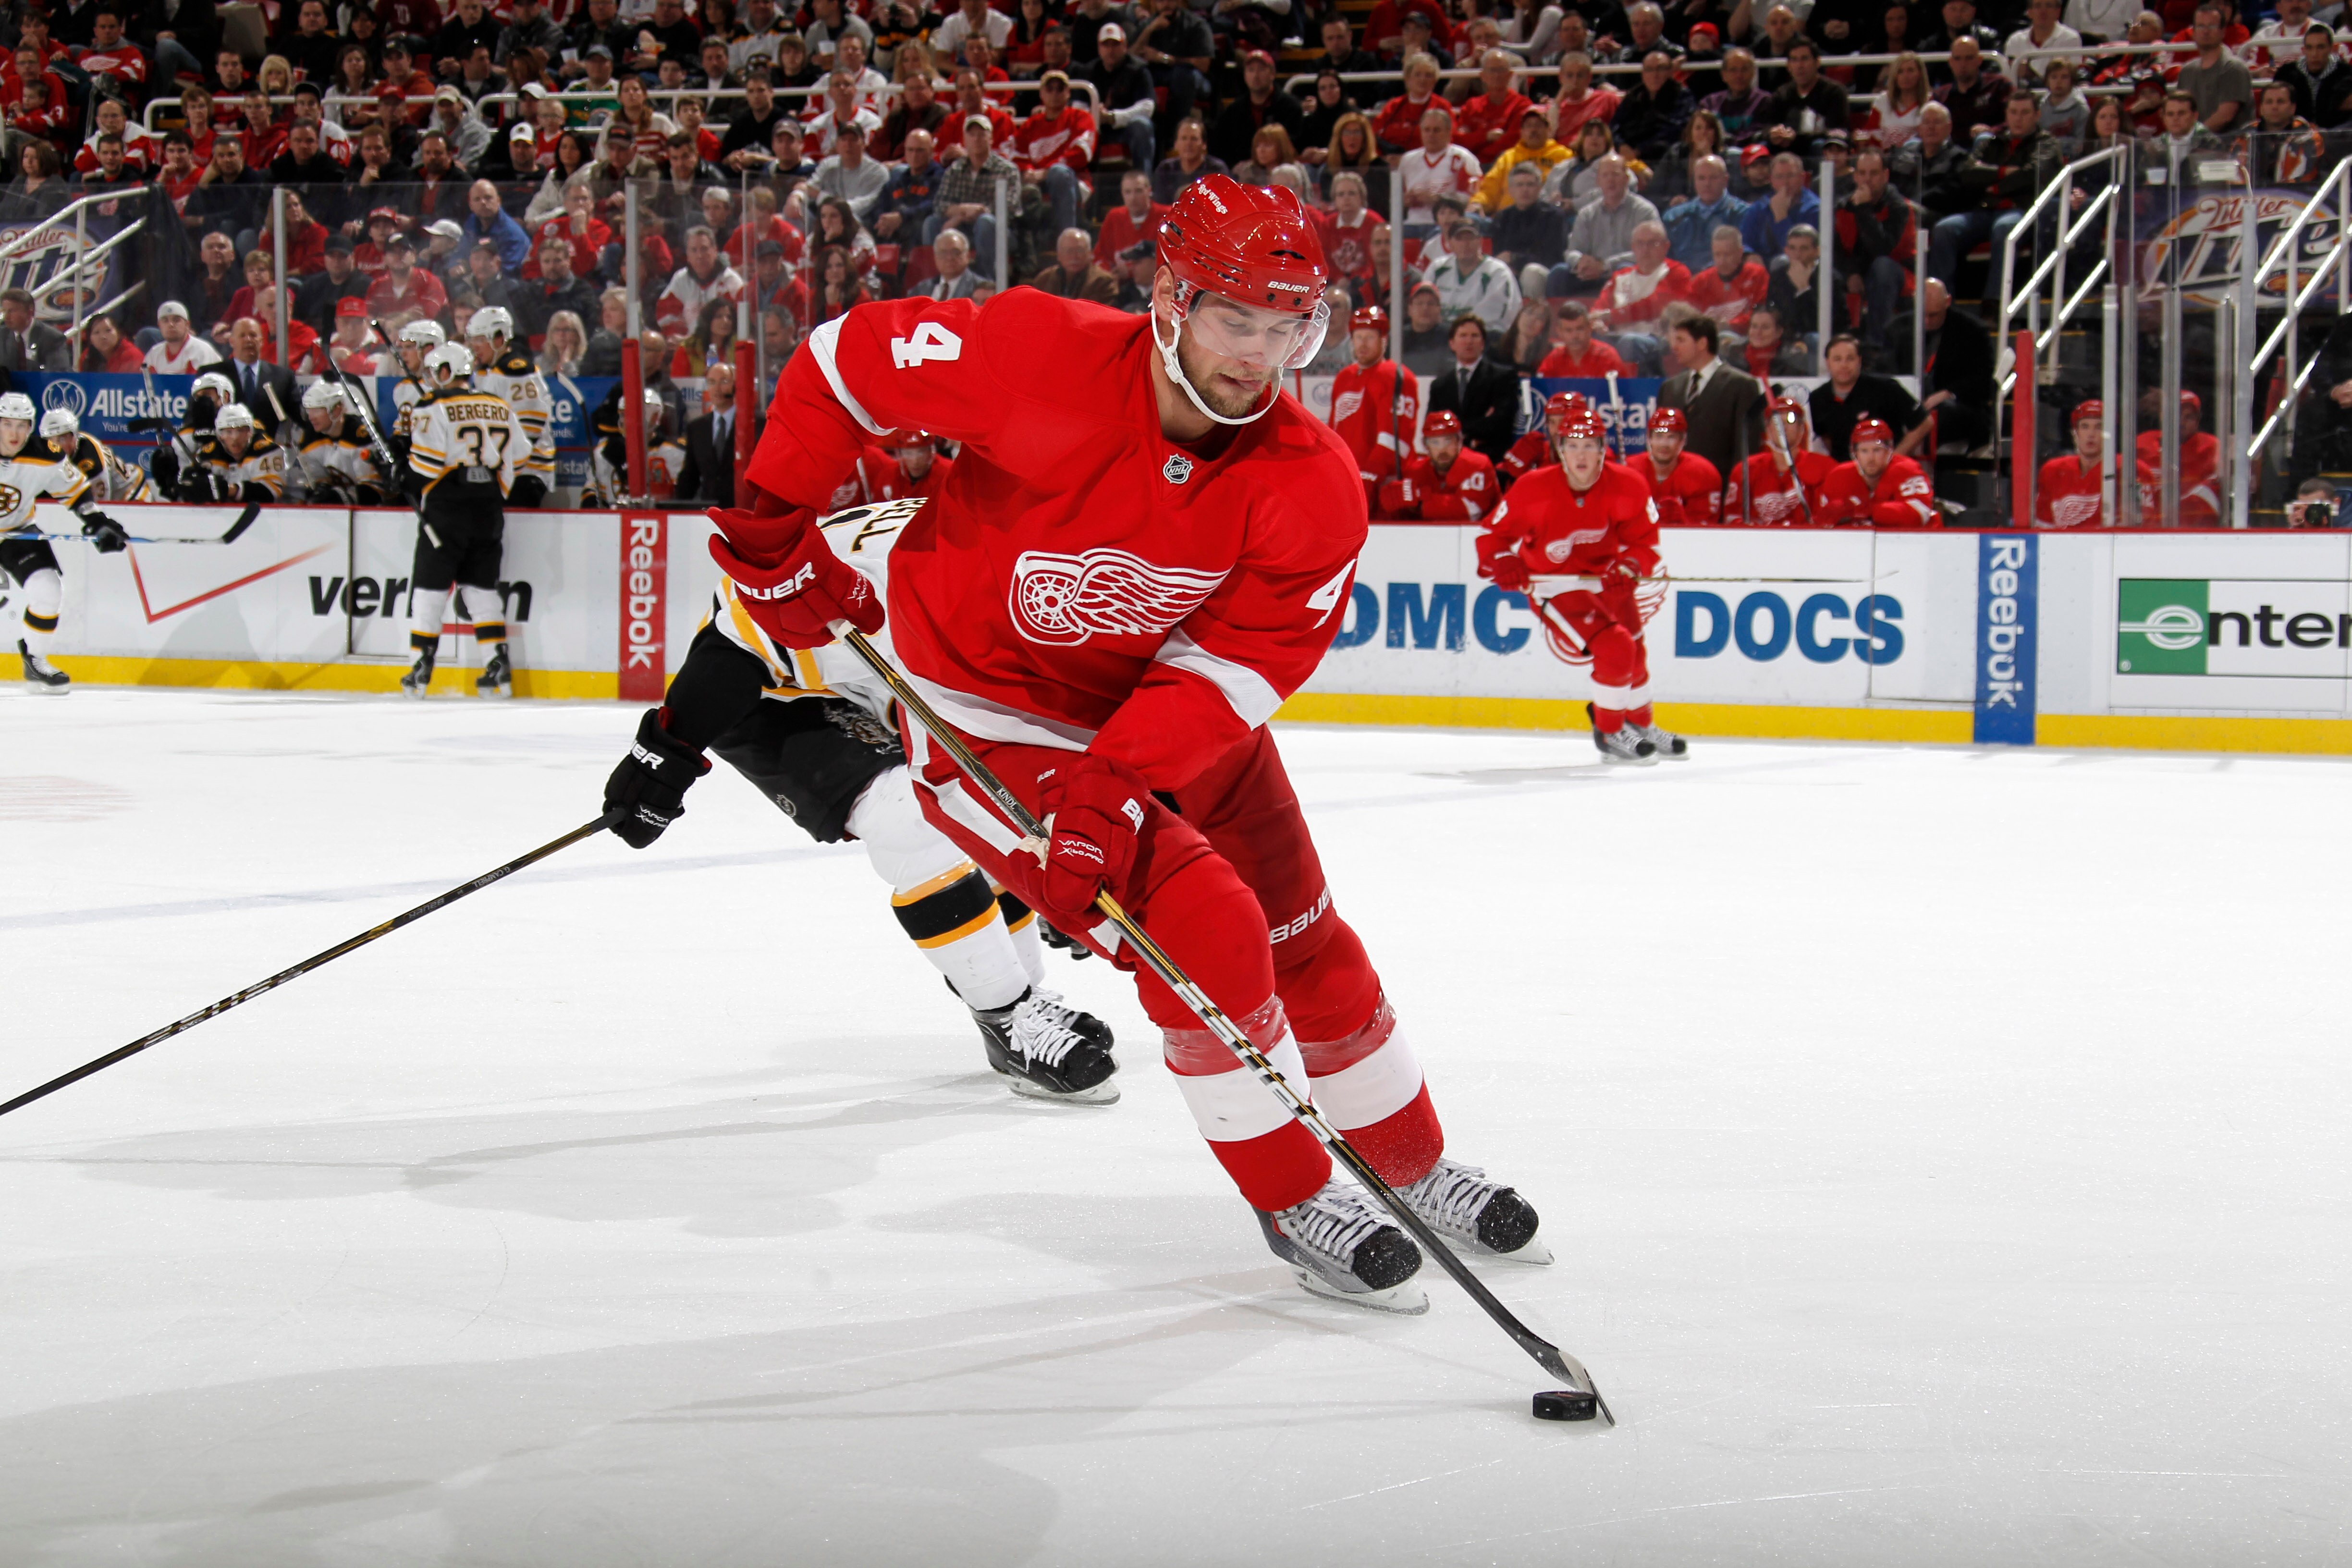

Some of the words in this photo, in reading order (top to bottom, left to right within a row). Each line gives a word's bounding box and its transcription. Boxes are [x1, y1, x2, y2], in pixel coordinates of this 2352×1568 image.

[1198, 183, 1208, 196] Red
[1207, 192, 1228, 215] Wings
[891, 322, 962, 369] 4
[88, 388, 188, 418] Allstate
[456, 424, 511, 470] 37
[308, 576, 532, 623] vern
[628, 519, 659, 670] Reebok
[1675, 590, 1905, 666] DOCS
[1987, 538, 2026, 710] Reebok
[996, 786, 1020, 810] KINDL
[1058, 839, 1104, 859] VAPOR
[1269, 884, 1332, 945] BAUE
